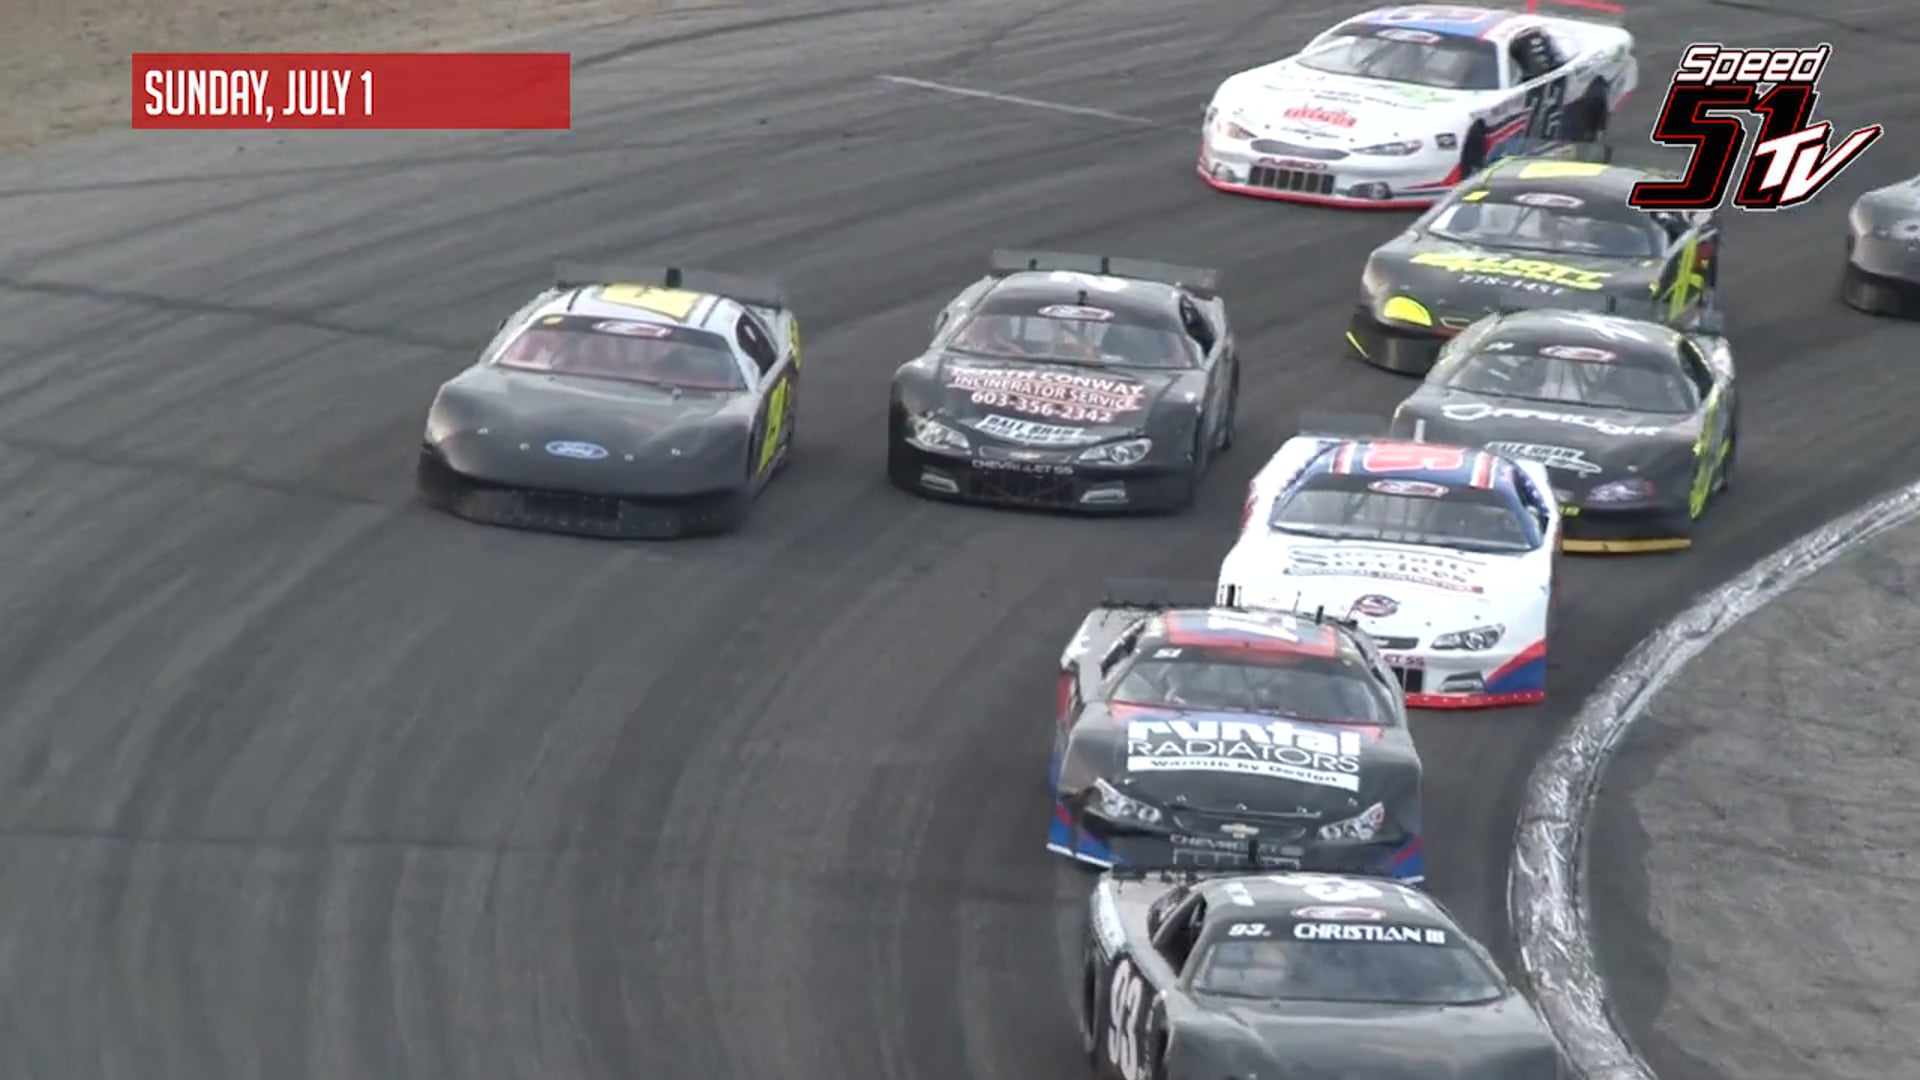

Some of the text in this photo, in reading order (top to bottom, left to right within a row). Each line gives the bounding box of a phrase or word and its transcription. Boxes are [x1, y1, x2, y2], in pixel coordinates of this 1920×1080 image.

[954, 374, 1137, 410] INCINERATOR SERVICE
[1041, 372, 1145, 396] CONWAY
[971, 391, 1112, 422] 603-356-2342
[1127, 720, 1361, 756] runtal
[1128, 739, 1361, 774] RADIATORS
[1151, 759, 1338, 783] Warmth by Design
[1293, 922, 1422, 943] CHRISTIAN
[1108, 958, 1143, 1080] 93
